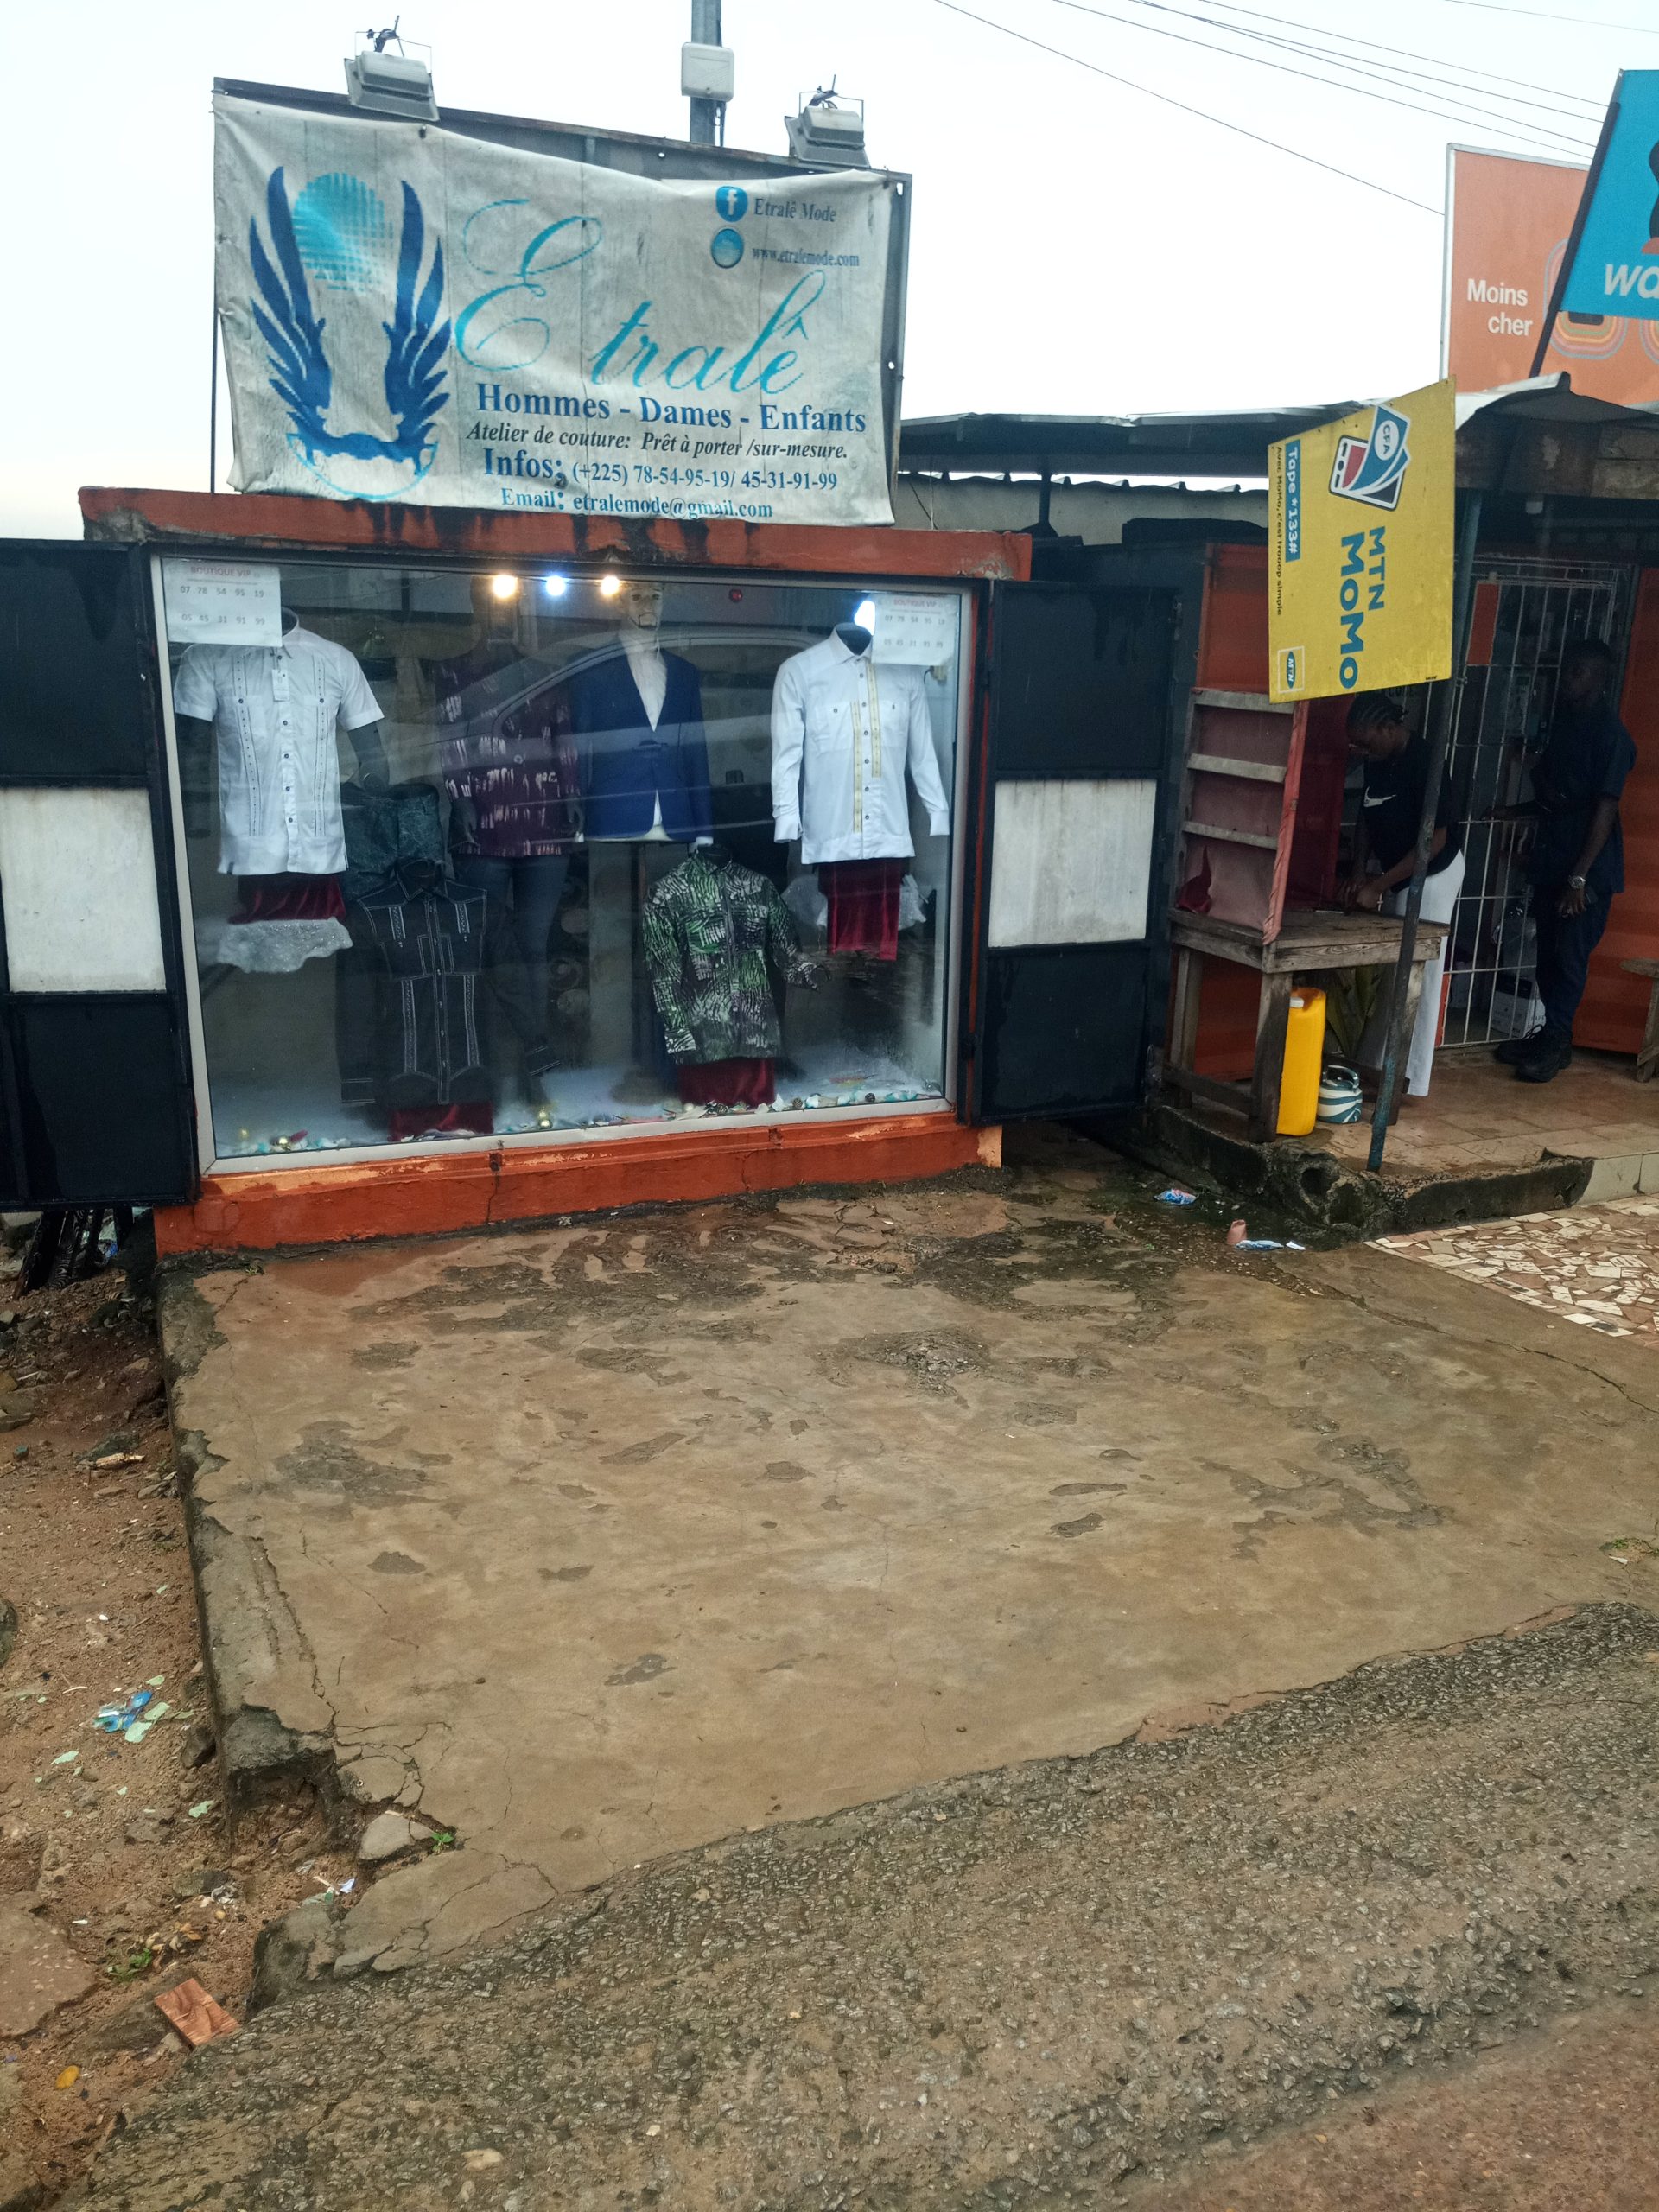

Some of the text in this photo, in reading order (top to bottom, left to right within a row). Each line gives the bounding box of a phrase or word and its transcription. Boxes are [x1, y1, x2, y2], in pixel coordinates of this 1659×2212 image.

[802, 203, 836, 222] Mode
[1467, 278, 1529, 307] Moins
[1487, 312, 1533, 336] cher
[477, 383, 611, 420] Hommes
[639, 397, 732, 429] Dames
[760, 404, 867, 432] Enfants
[467, 421, 529, 442] Atelier
[534, 425, 554, 443] de
[559, 431, 631, 448] couture:
[641, 432, 676, 452] Prêt
[680, 435, 690, 453] à
[692, 439, 743, 459] porter
[1382, 423, 1392, 455] CFA
[573, 462, 628, 486] (+225)
[741, 470, 837, 490] 45-31-91-99
[1287, 447, 1298, 493] Tape
[501, 487, 773, 518] Email: etralemode@gmail.com
[191, 566, 235, 576] BOUTIQUE
[1369, 525, 1386, 611] MTN
[180, 585, 190, 594] 07
[254, 589, 264, 598] 19
[218, 615, 227, 624] 31
[1339, 531, 1365, 690] MoMo
